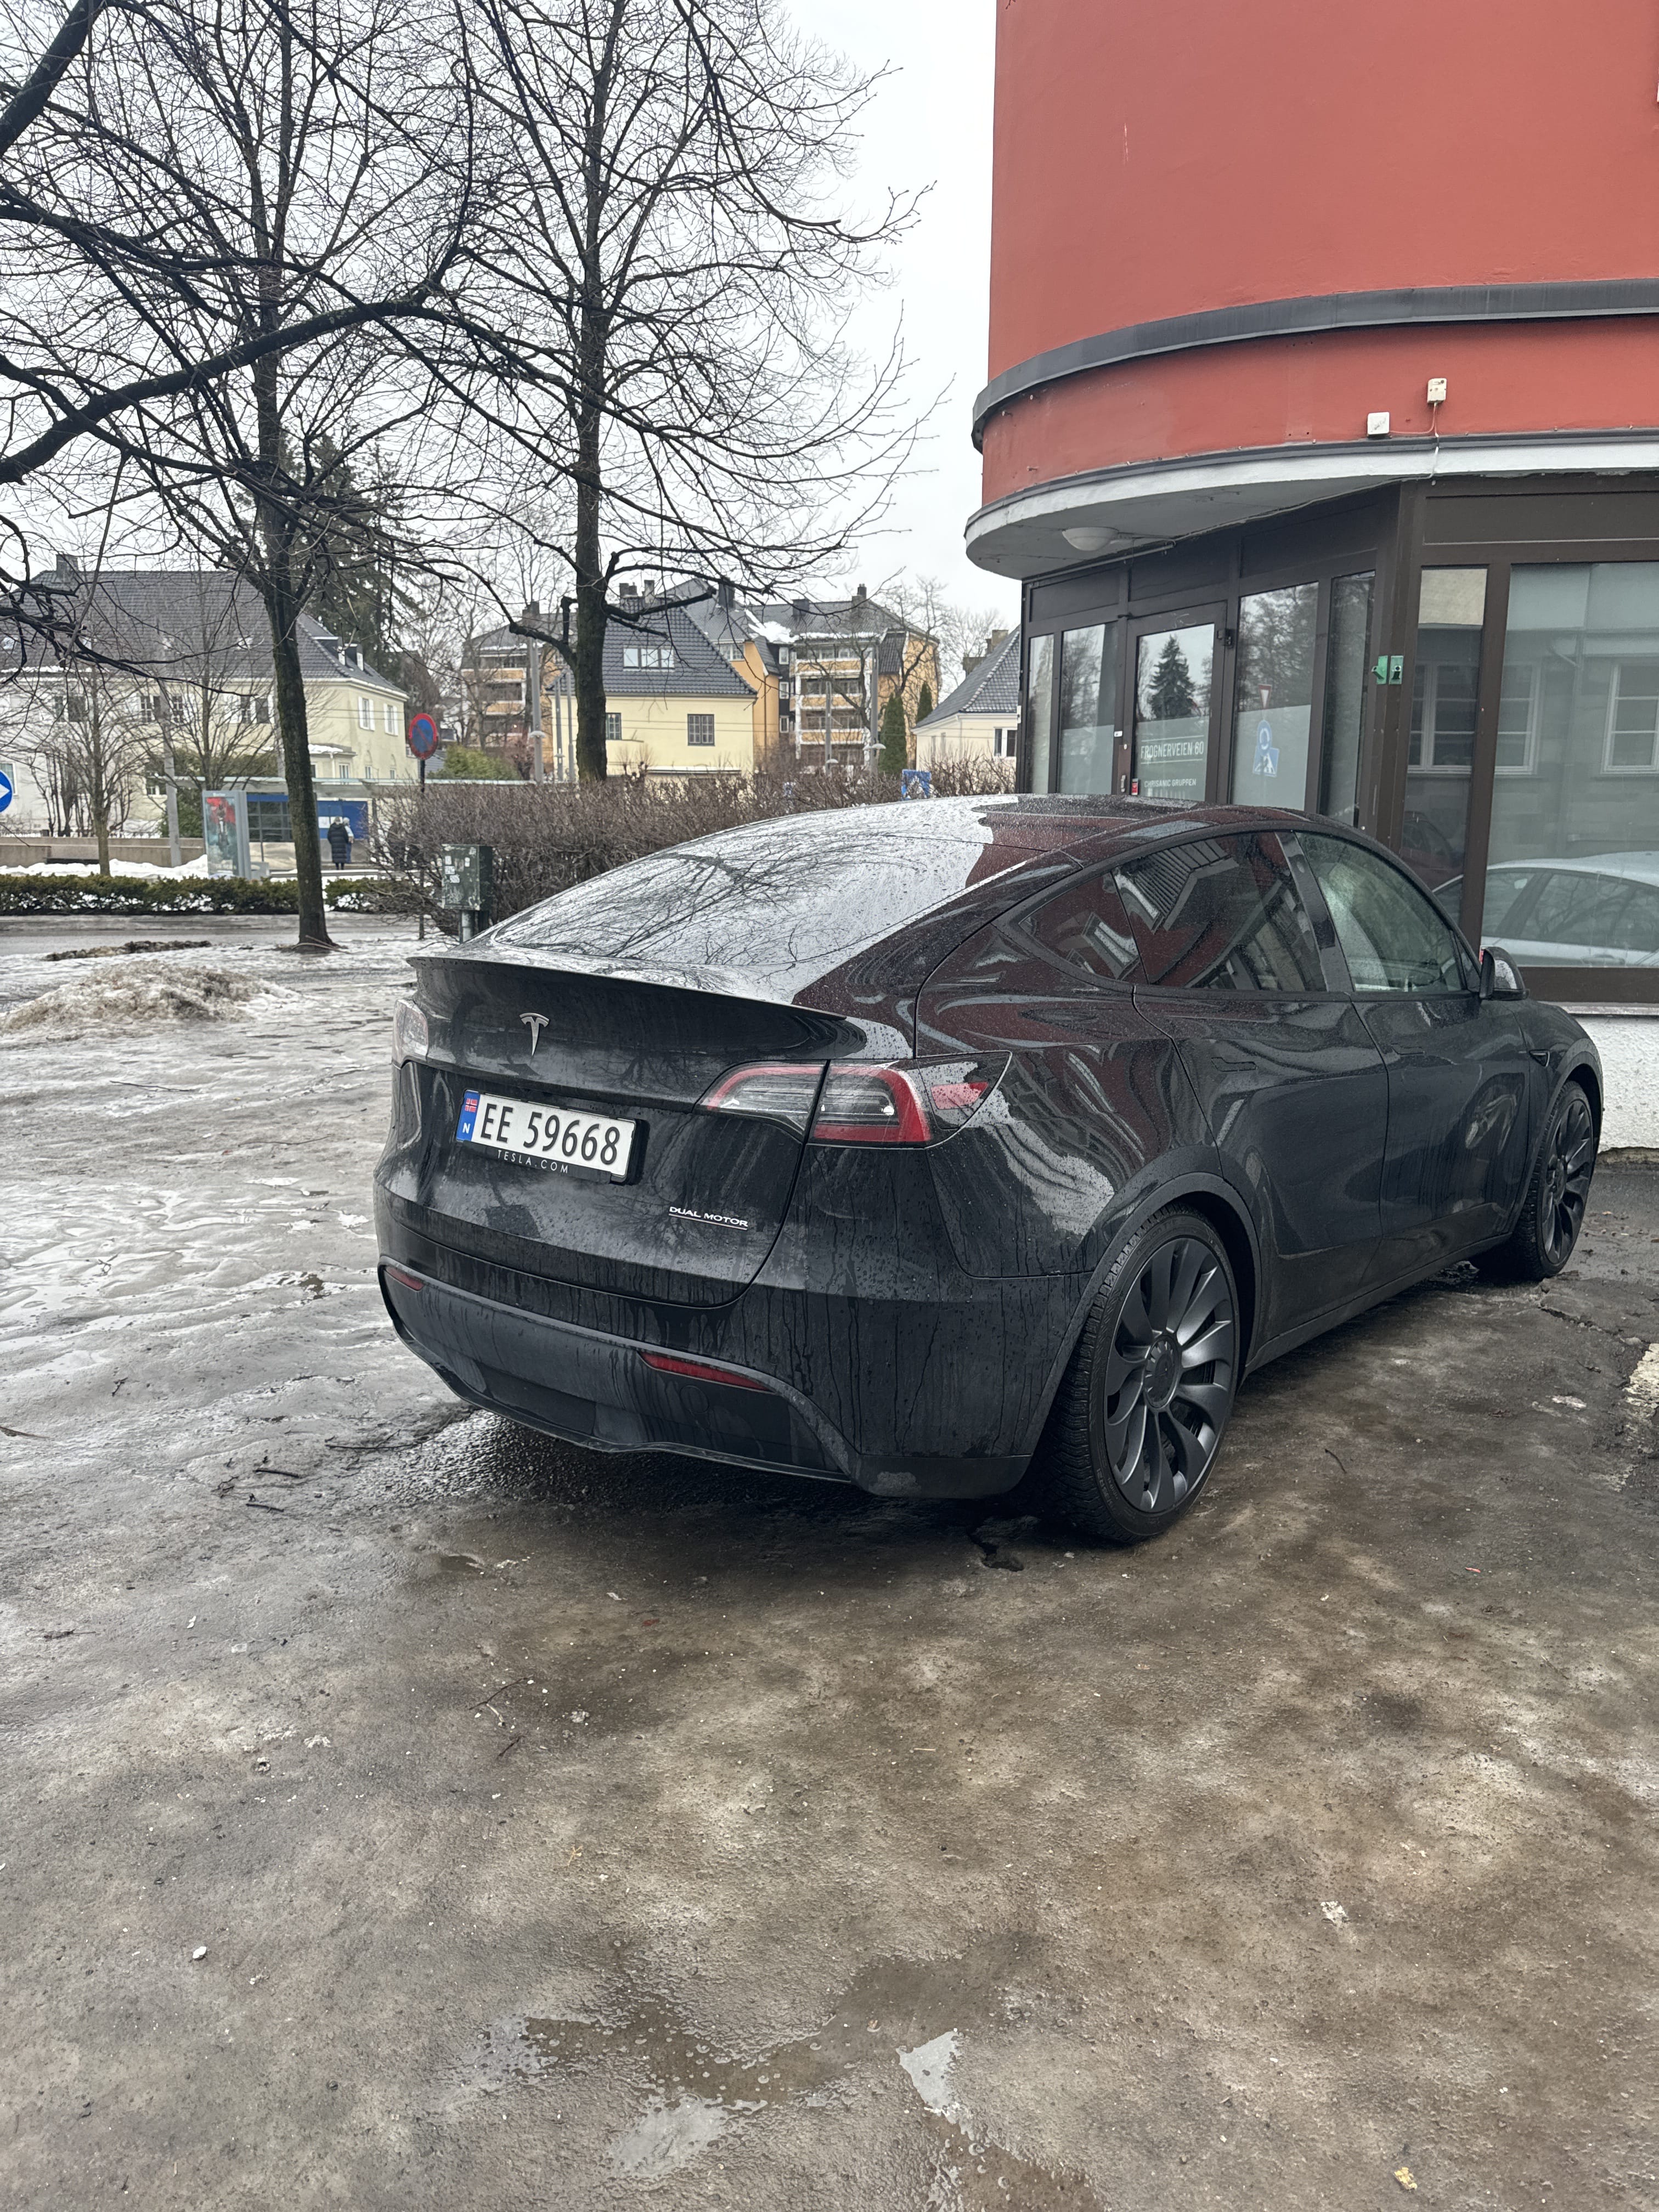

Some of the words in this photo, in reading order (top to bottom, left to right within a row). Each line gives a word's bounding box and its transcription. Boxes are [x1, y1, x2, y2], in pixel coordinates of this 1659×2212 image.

[1141, 742, 1193, 759] FROGNERVEIEN
[1194, 741, 1204, 755] 60
[462, 1122, 471, 1134] N
[480, 1103, 514, 1143] EE
[523, 1110, 620, 1165] 59668
[497, 1149, 568, 1174] TESLA.COM
[669, 1206, 701, 1218] DUAL
[703, 1212, 749, 1227] MOTOR
